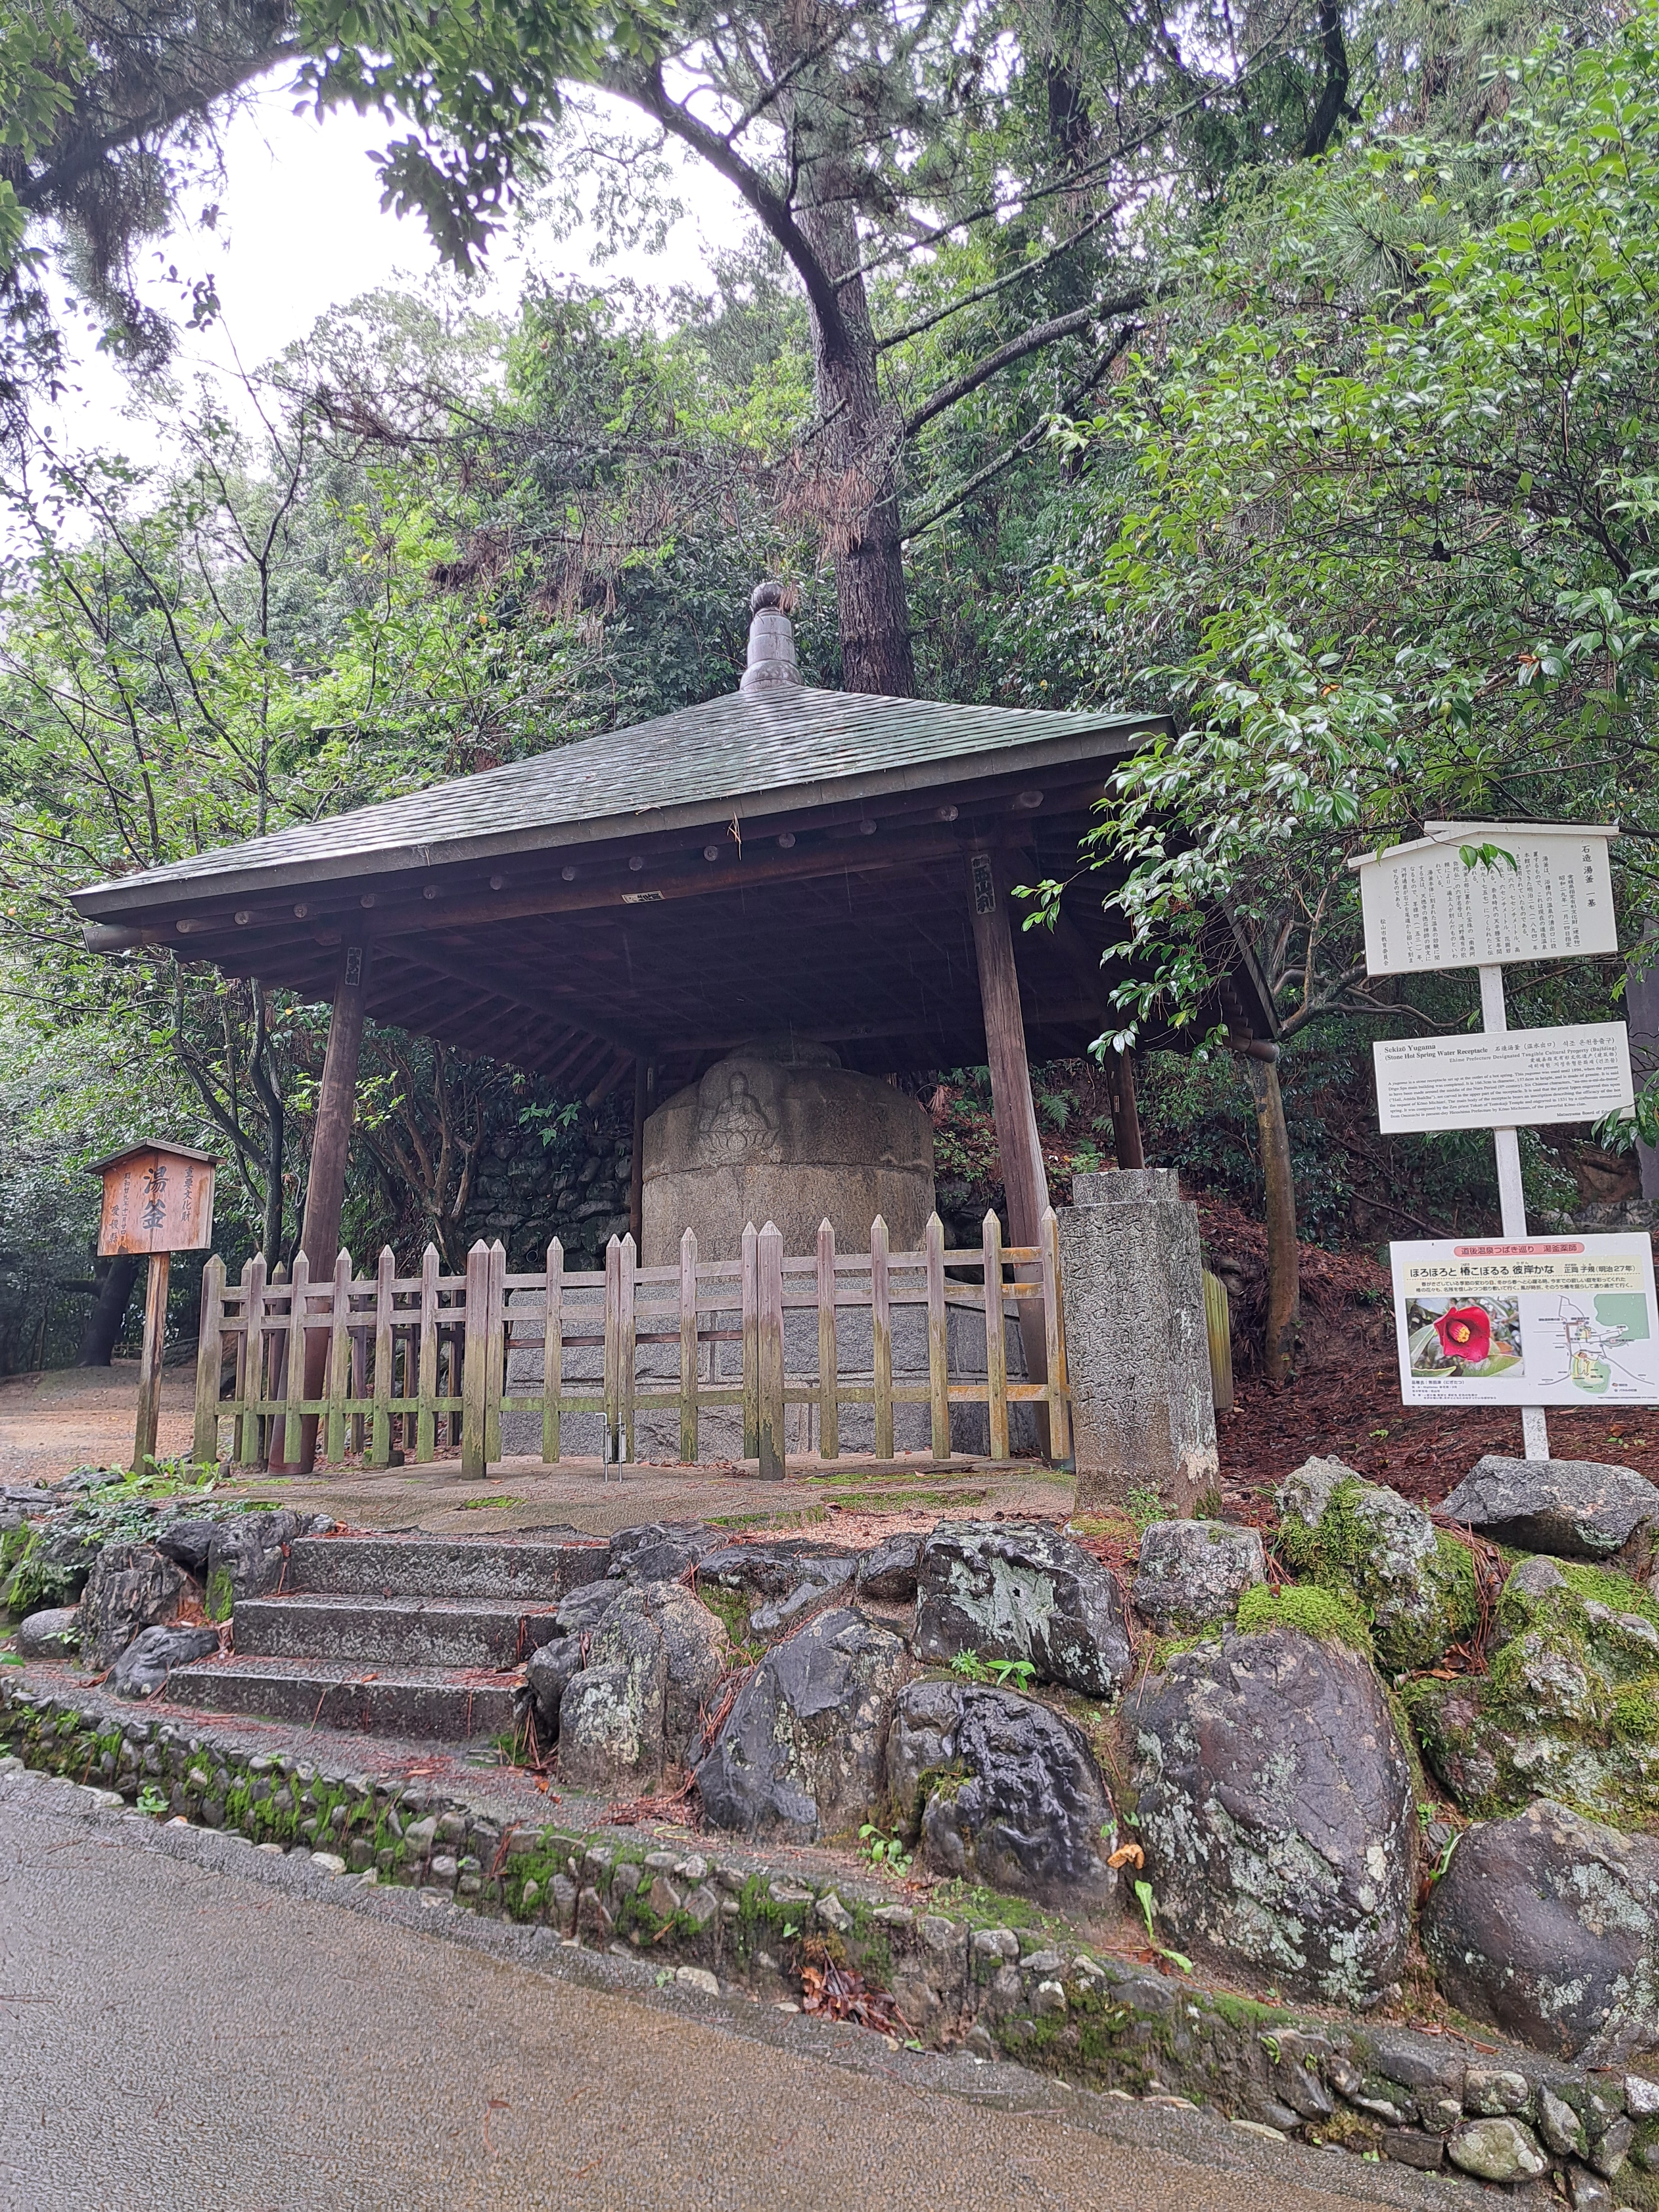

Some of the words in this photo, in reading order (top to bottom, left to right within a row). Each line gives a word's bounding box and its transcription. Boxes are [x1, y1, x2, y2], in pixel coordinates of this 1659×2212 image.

[1582, 845, 1592, 862] 石造
[1583, 865, 1594, 884] 湯釜
[1586, 892, 1596, 907] 一基
[1380, 918, 1389, 966] 松山市教育委員会
[1457, 1047, 1488, 1055] Receptacle
[140, 1166, 169, 1229] 湯釜
[181, 1165, 194, 1222] 重要文化財
[1461, 1246, 1534, 1255] 道後温泉つばき巡り
[1543, 1244, 1577, 1252] 湯釜薬師
[1410, 1268, 1457, 1277] ほろほろと
[1460, 1266, 1509, 1276] 椿こぼるる
[1513, 1265, 1555, 1275] 彼岸かな
